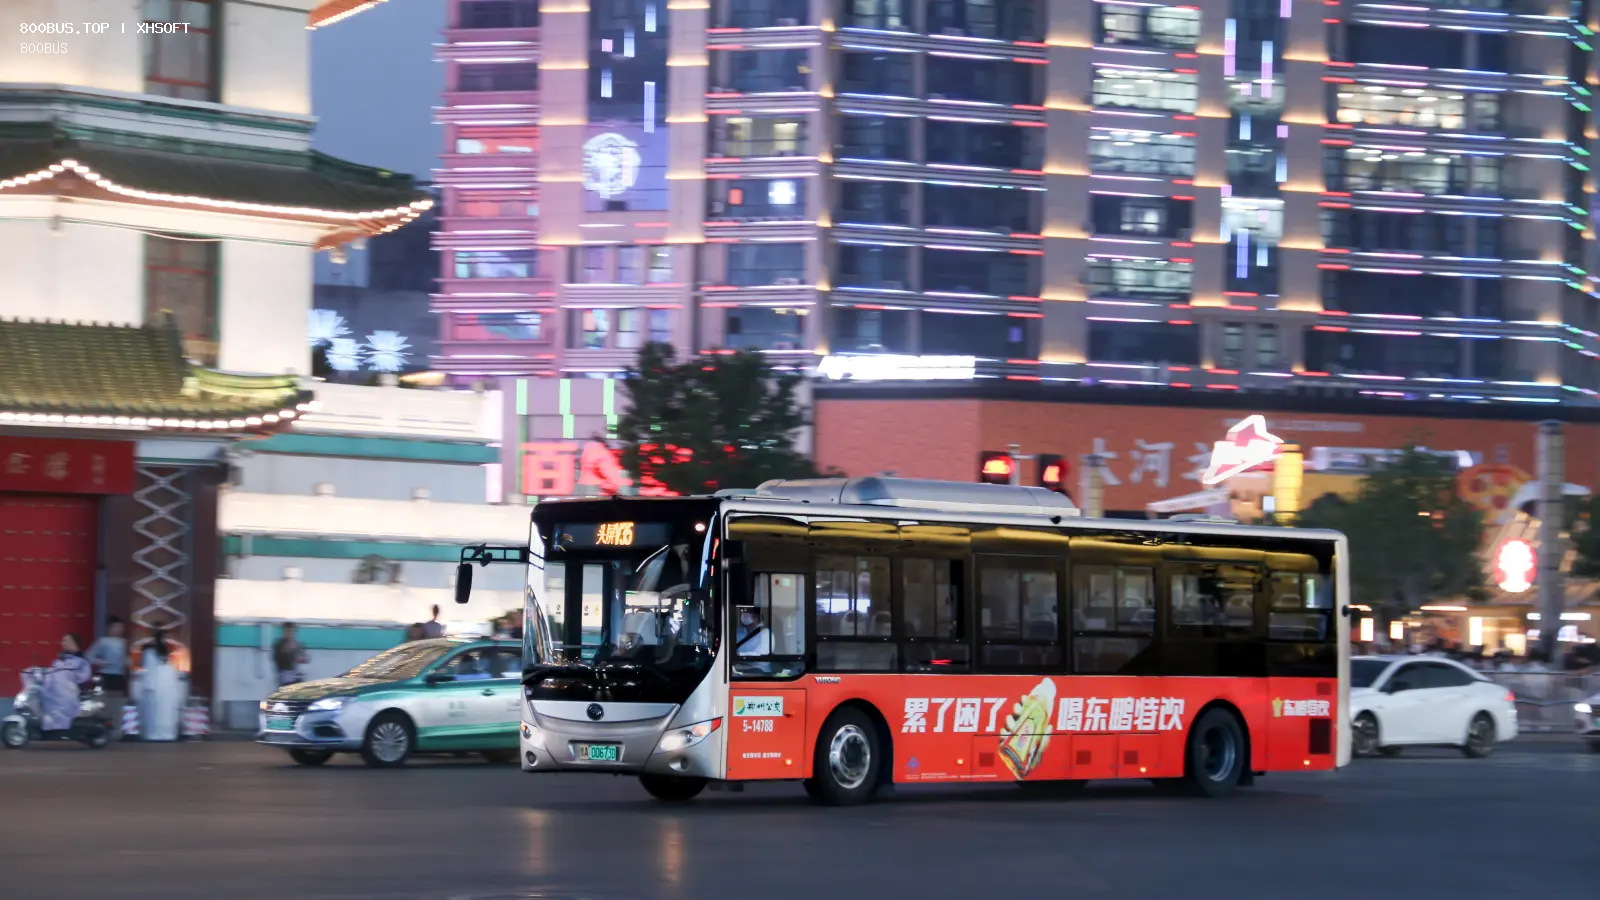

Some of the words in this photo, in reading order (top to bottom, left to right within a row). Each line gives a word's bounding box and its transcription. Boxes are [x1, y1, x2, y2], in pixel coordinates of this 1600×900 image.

[742, 719, 774, 732] 5-14788
[901, 697, 1007, 733] 累了困了
[1056, 697, 1185, 731] 喝东鹏特饮
